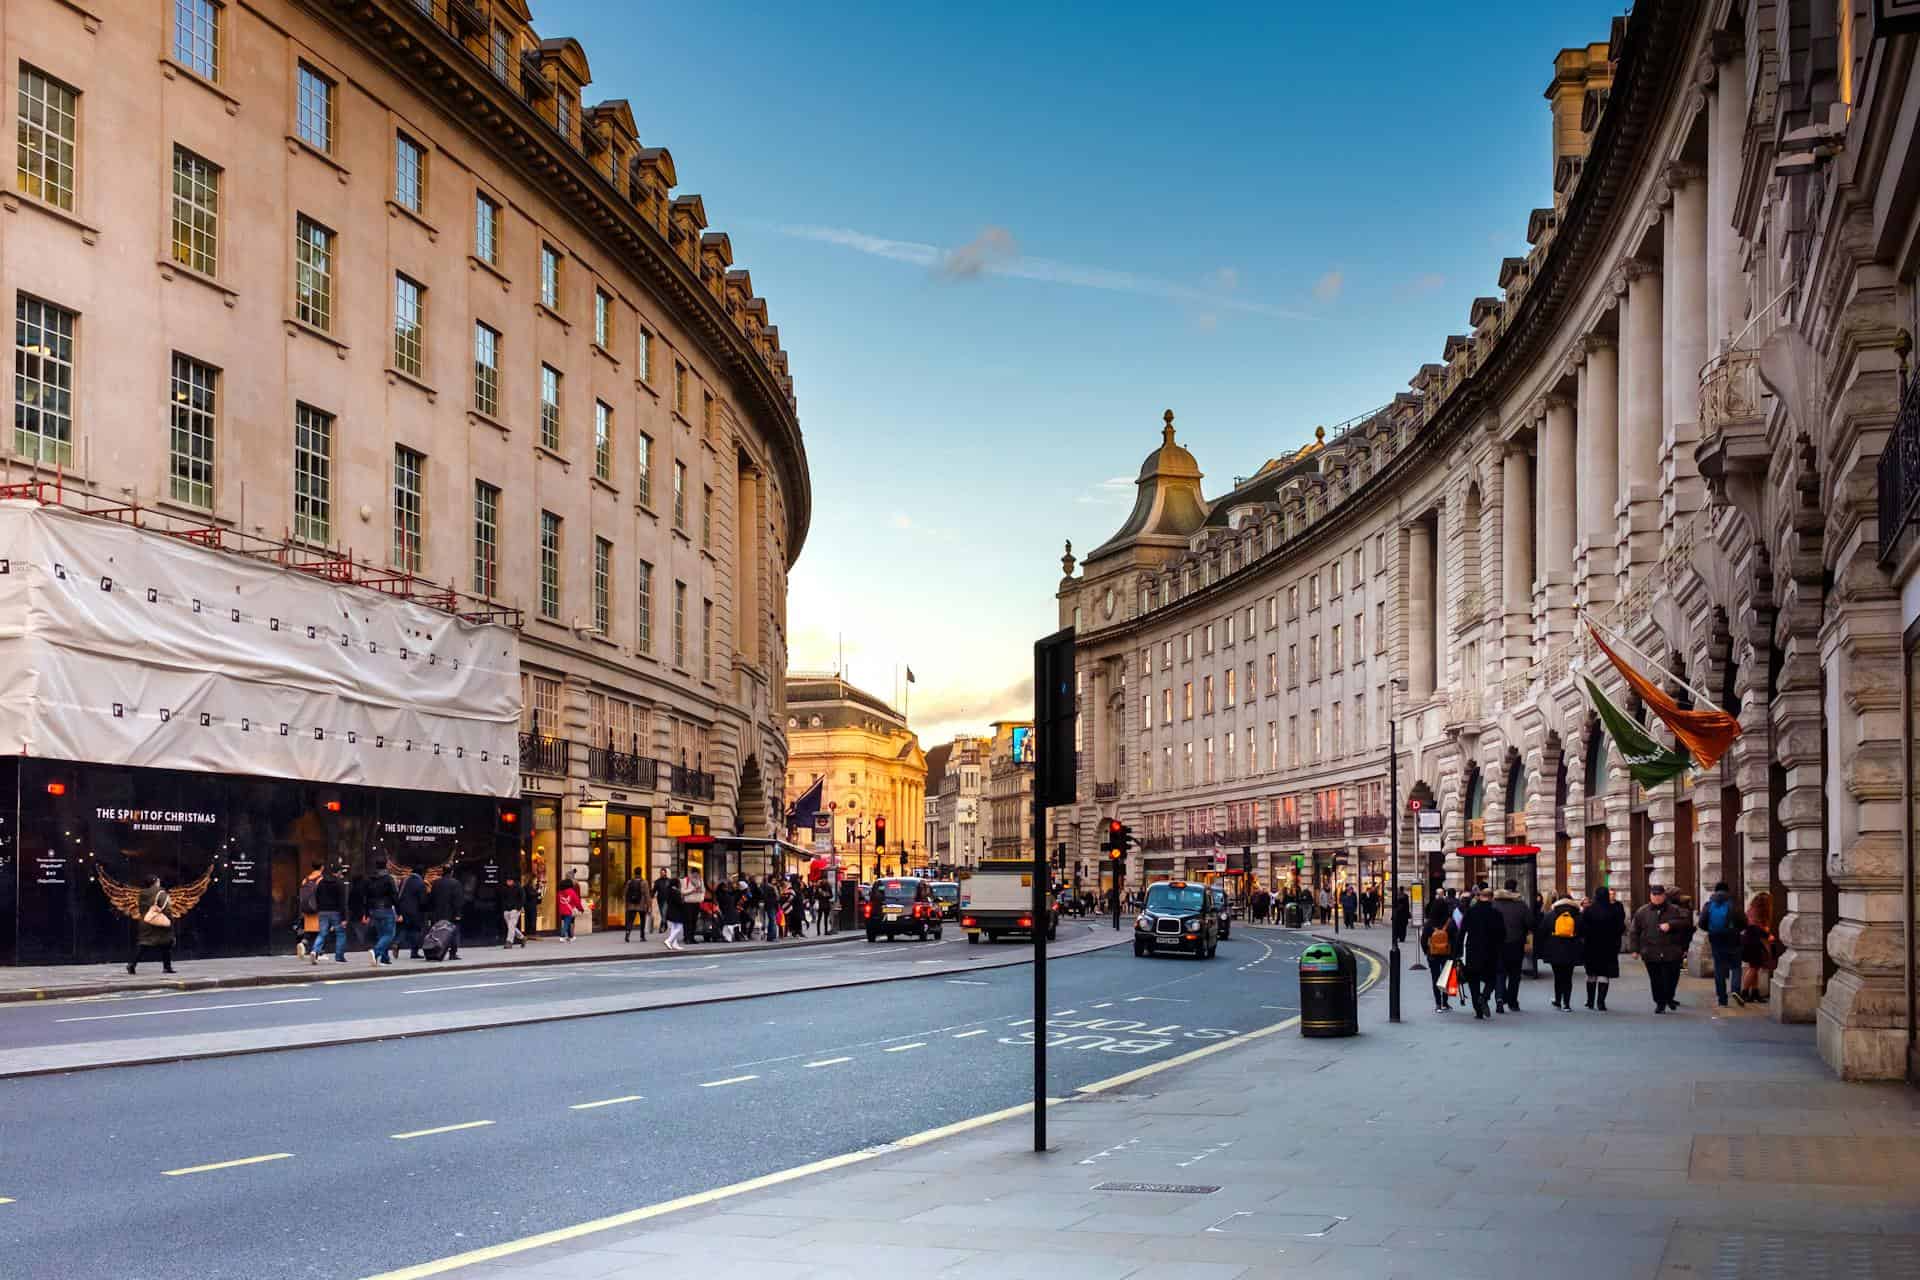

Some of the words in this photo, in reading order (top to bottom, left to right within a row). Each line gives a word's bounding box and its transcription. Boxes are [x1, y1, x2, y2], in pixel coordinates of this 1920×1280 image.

[1412, 800, 1420, 809] D
[96, 808, 115, 819] THE
[150, 810, 163, 821] OF
[164, 811, 216, 824] CHRISTMAS
[384, 823, 396, 833] THE
[416, 824, 424, 834] OF
[424, 825, 456, 835] CHRISTMAS
[997, 1031, 1175, 1054] BUS
